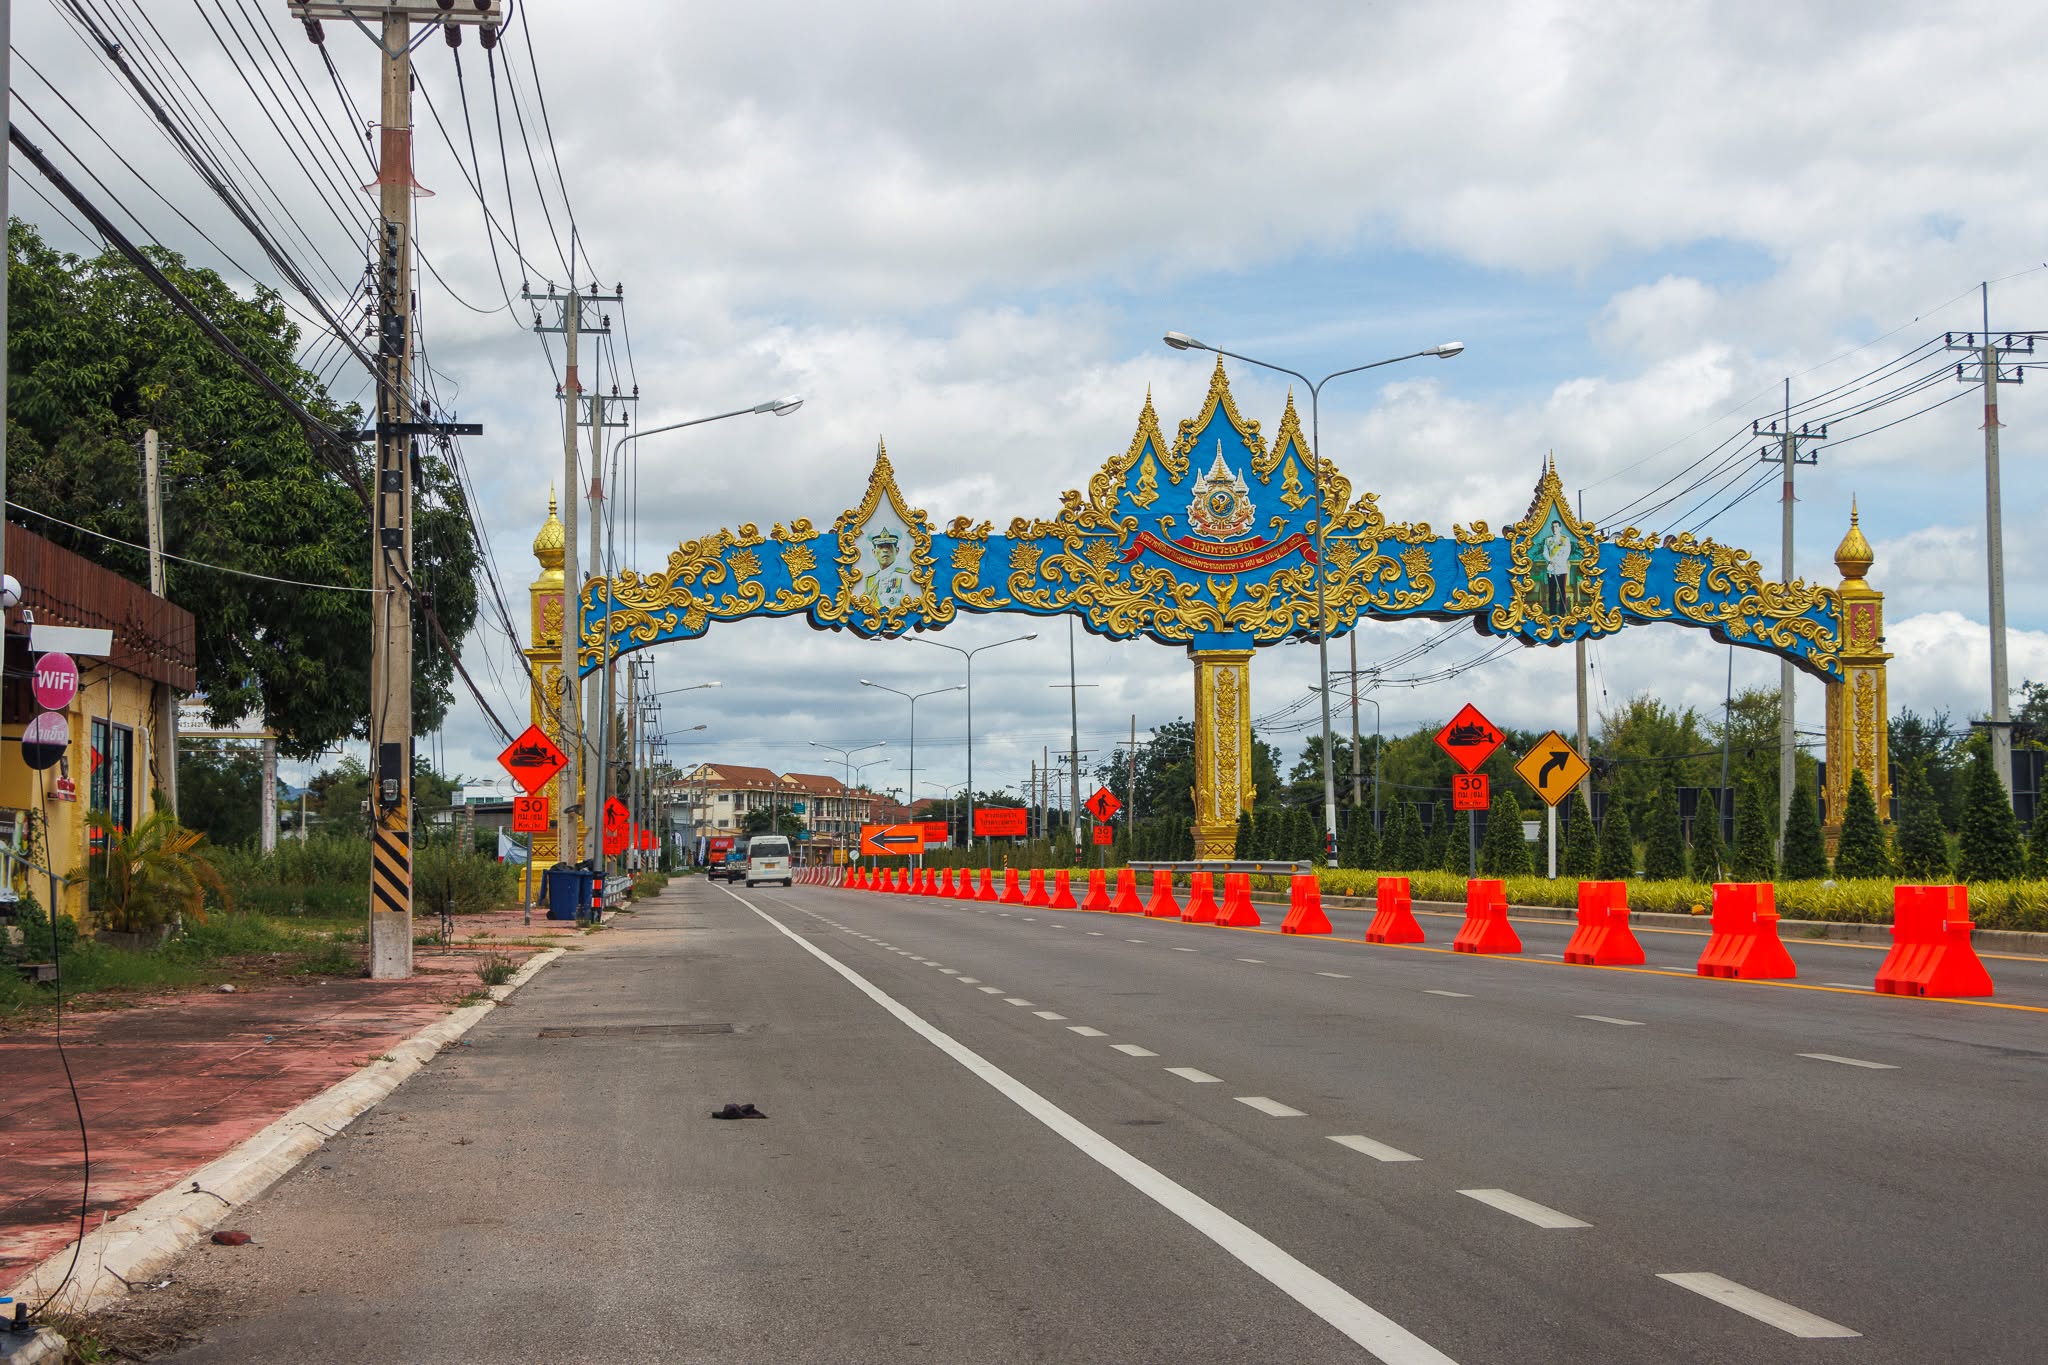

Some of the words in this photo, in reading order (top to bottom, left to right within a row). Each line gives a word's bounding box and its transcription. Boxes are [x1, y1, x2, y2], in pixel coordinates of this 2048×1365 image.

[1192, 541, 1254, 554] ทรงพระเจริญ
[38, 670, 75, 691] WiFi
[1460, 778, 1482, 790] 30
[519, 799, 543, 812] 30
[1097, 827, 1109, 835] 30
